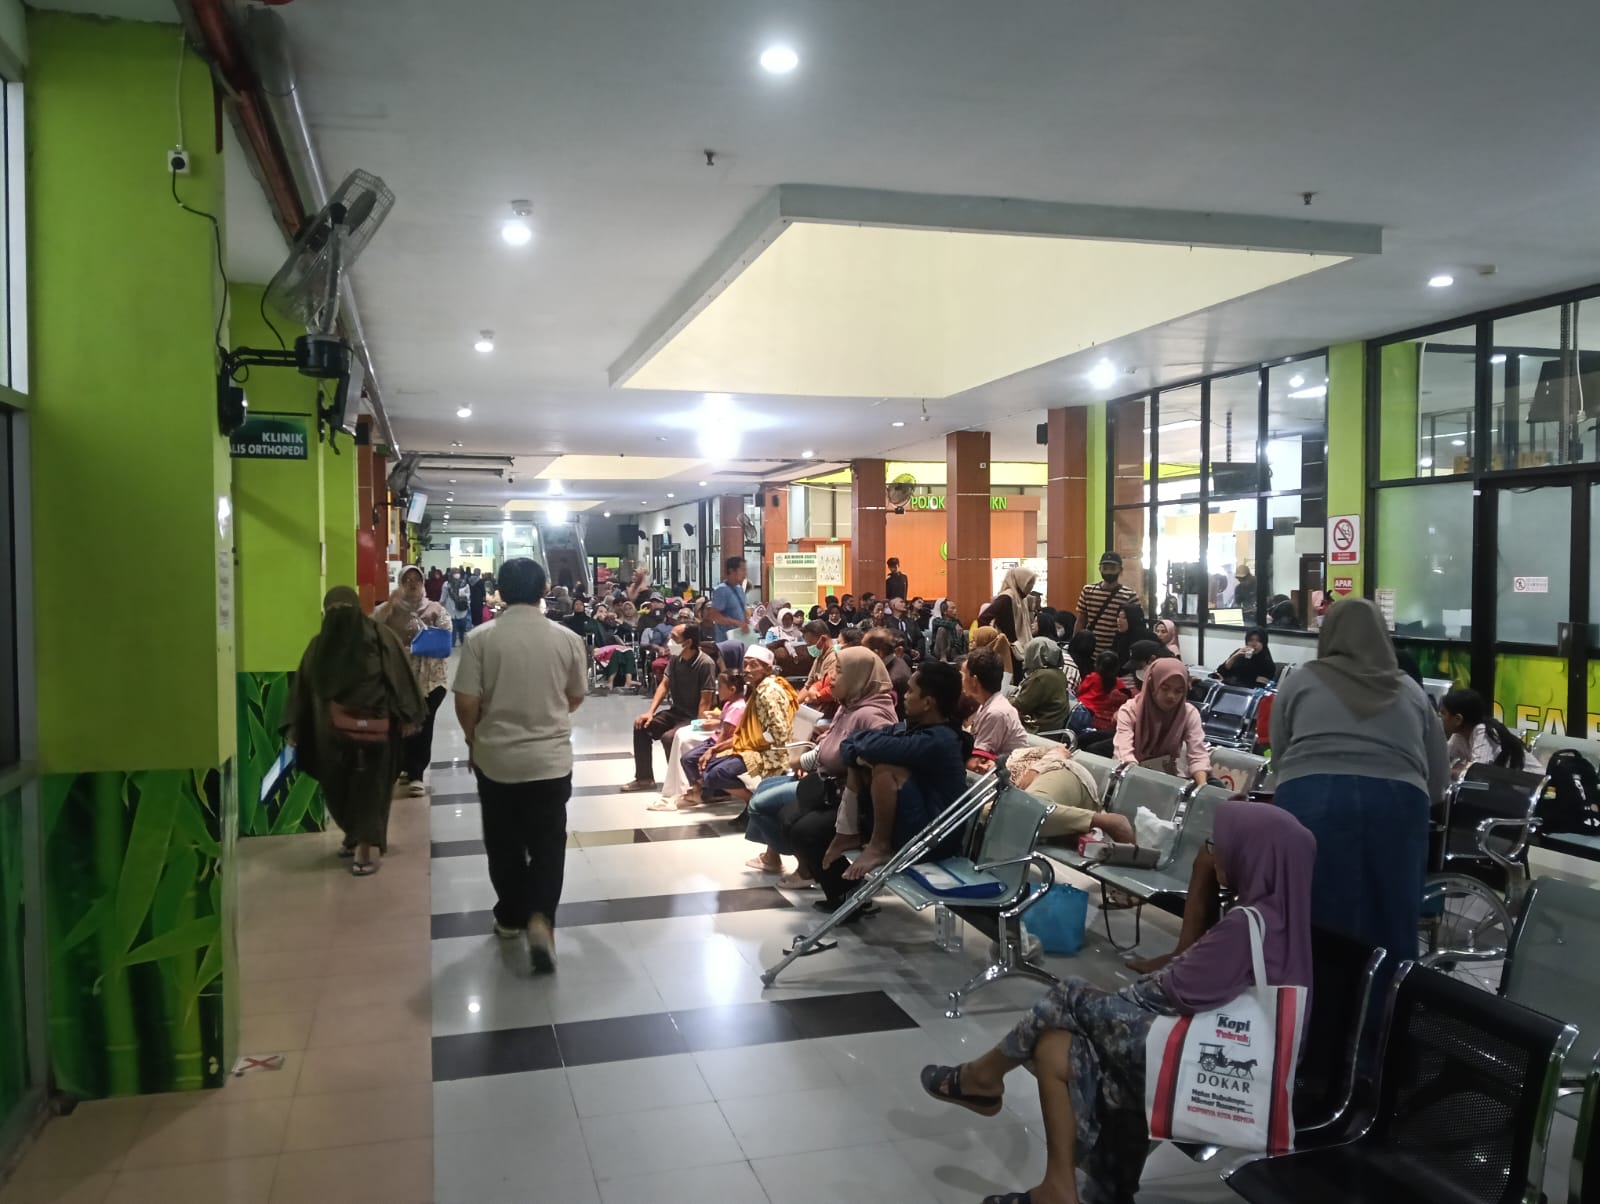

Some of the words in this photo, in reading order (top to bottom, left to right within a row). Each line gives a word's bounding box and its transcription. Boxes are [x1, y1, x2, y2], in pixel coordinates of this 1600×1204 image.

[262, 432, 304, 443] KLINIK
[231, 444, 246, 454] LIS
[248, 444, 304, 455] ORTHOPEDI
[911, 495, 945, 510] POJOK
[1335, 579, 1353, 588] APAR
[1217, 1016, 1251, 1033] Kopi
[1196, 1072, 1251, 1094] DOKAR
